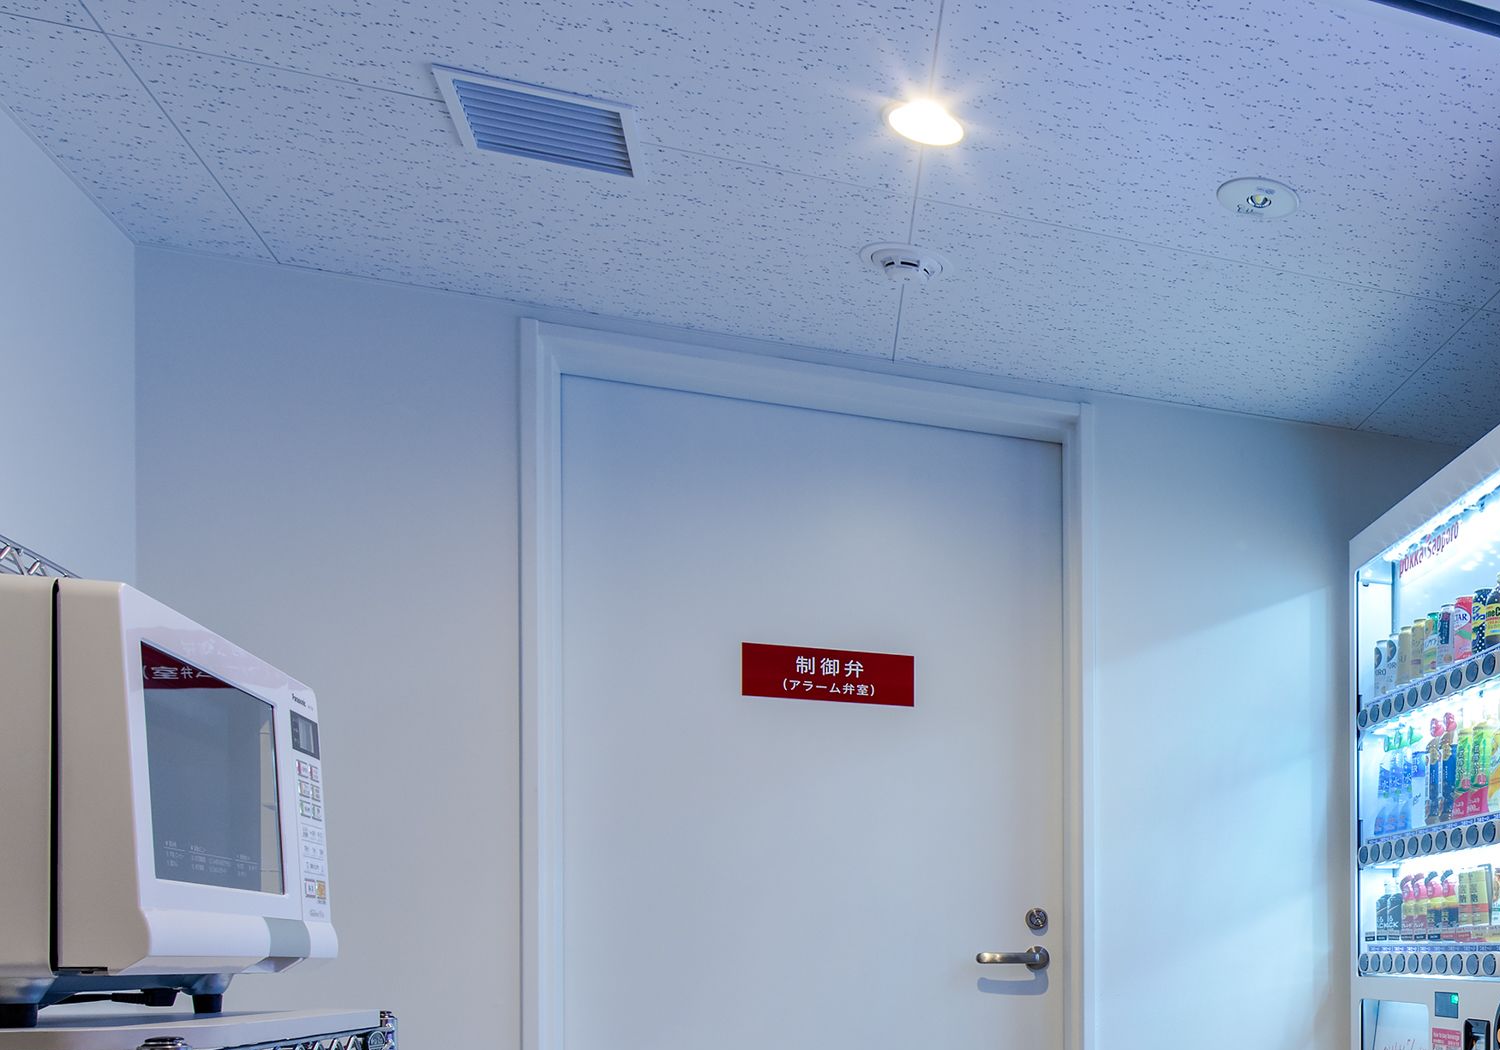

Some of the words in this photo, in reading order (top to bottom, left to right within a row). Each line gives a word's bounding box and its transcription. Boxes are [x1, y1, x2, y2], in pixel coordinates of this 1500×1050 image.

[796, 655, 864, 679] 制御弁
[782, 678, 875, 697] (アラーム弁室)
